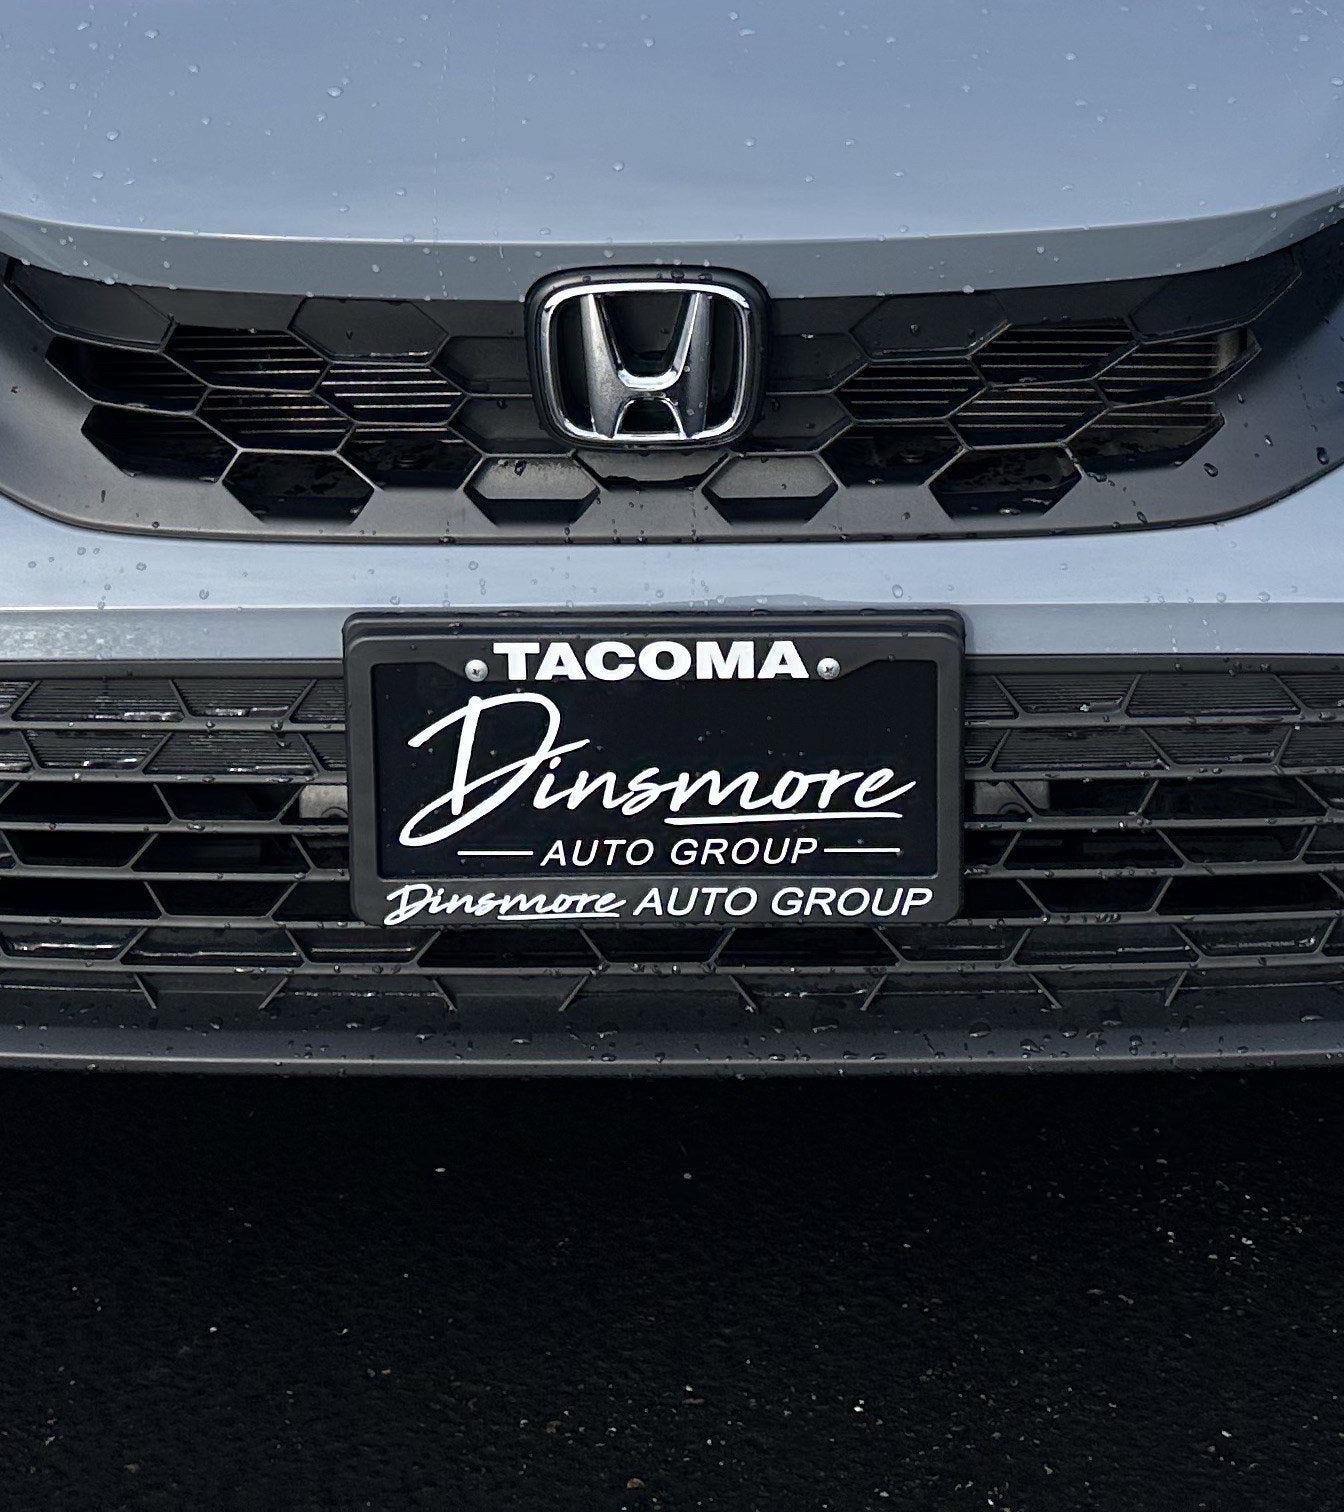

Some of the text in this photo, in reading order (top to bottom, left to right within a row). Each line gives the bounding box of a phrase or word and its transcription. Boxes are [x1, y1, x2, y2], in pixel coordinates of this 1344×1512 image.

[492, 640, 810, 681] TACOMA
[397, 691, 917, 848] Dinsmore
[540, 837, 819, 867] AUTO GROUP
[383, 883, 934, 926] Dinsmore AUTO GROUP
